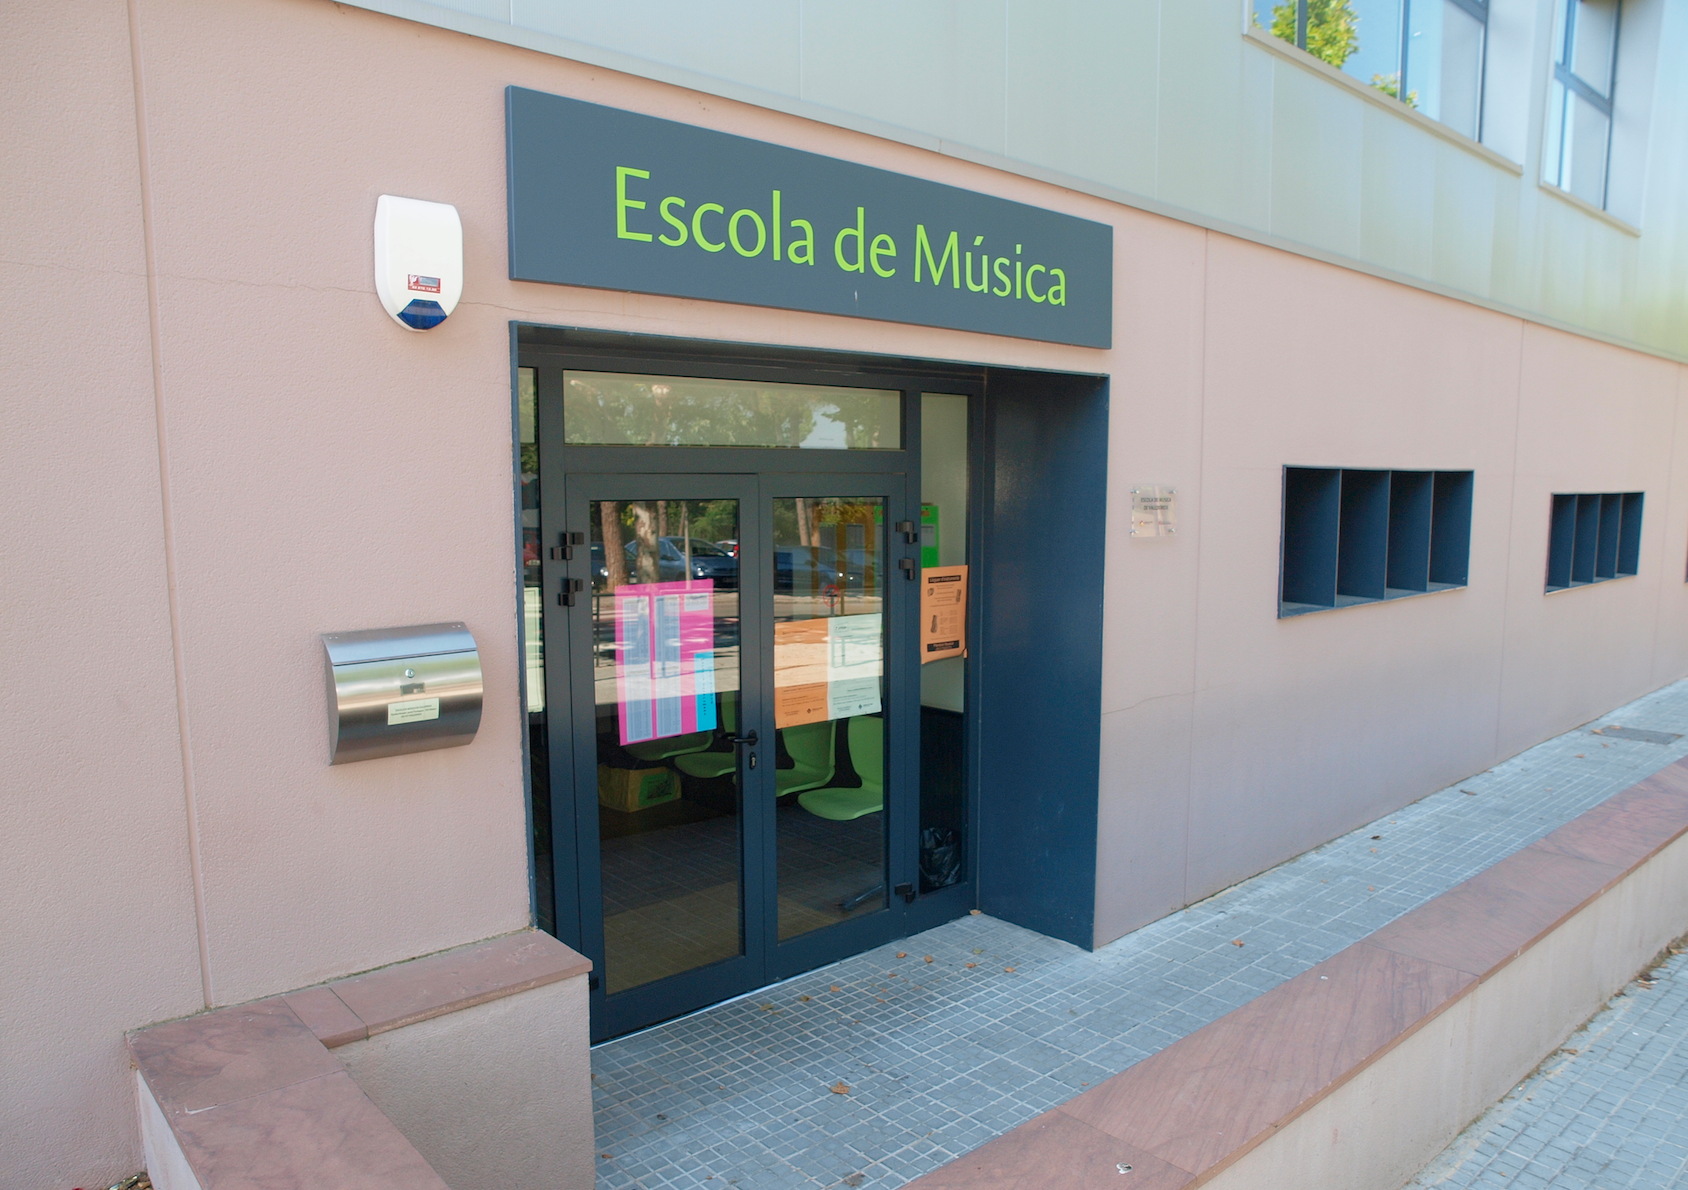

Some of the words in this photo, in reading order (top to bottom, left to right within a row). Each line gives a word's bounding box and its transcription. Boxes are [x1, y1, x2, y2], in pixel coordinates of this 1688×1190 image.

[615, 165, 815, 266] Escola
[834, 206, 897, 279] de
[914, 223, 1066, 307] Música
